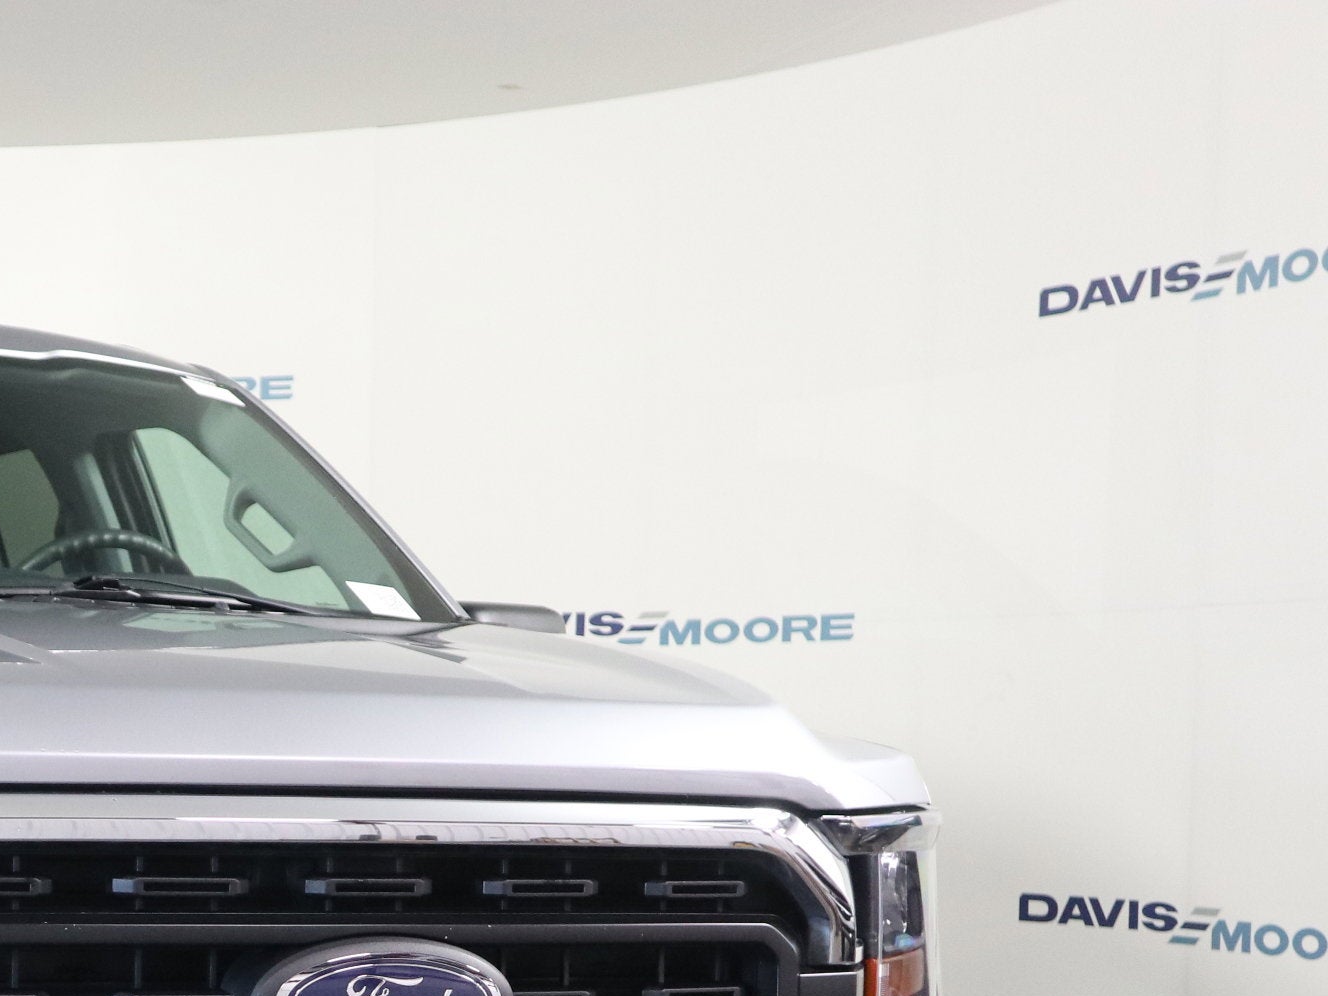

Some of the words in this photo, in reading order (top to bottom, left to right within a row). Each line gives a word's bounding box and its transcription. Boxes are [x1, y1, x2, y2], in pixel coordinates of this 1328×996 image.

[1039, 260, 1201, 319] DAVIS
[658, 613, 856, 647] MOORE
[1018, 892, 1179, 933] DAVIS
